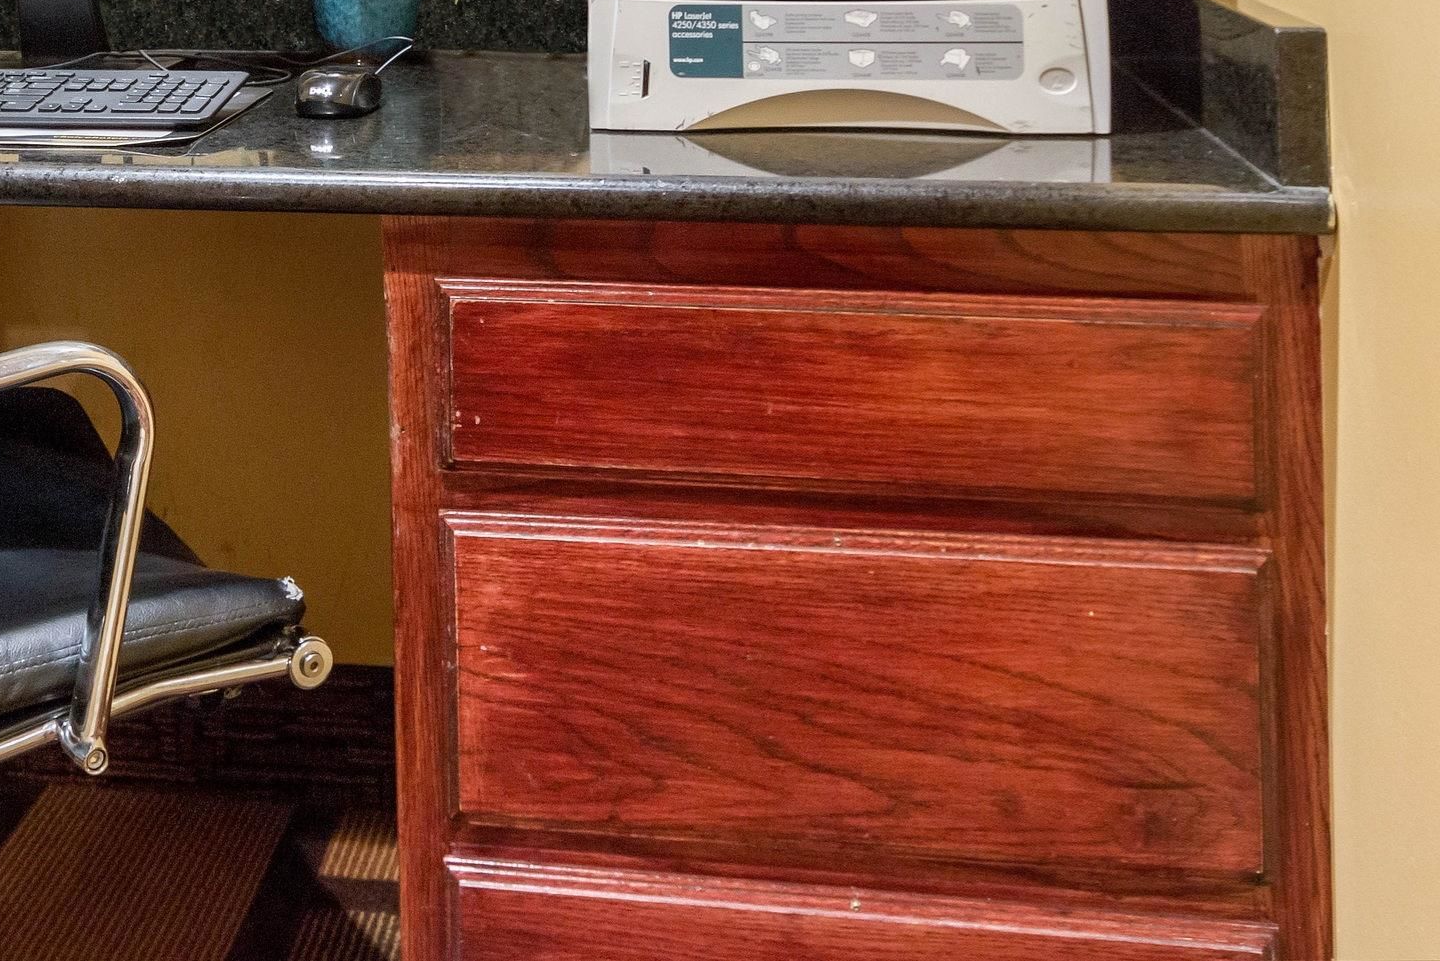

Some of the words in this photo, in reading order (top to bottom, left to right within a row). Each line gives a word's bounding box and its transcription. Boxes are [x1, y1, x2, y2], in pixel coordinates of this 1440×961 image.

[671, 11, 683, 20] HP
[671, 20, 717, 30] 4250/4350
[718, 21, 739, 30] series
[671, 30, 714, 39] accessories
